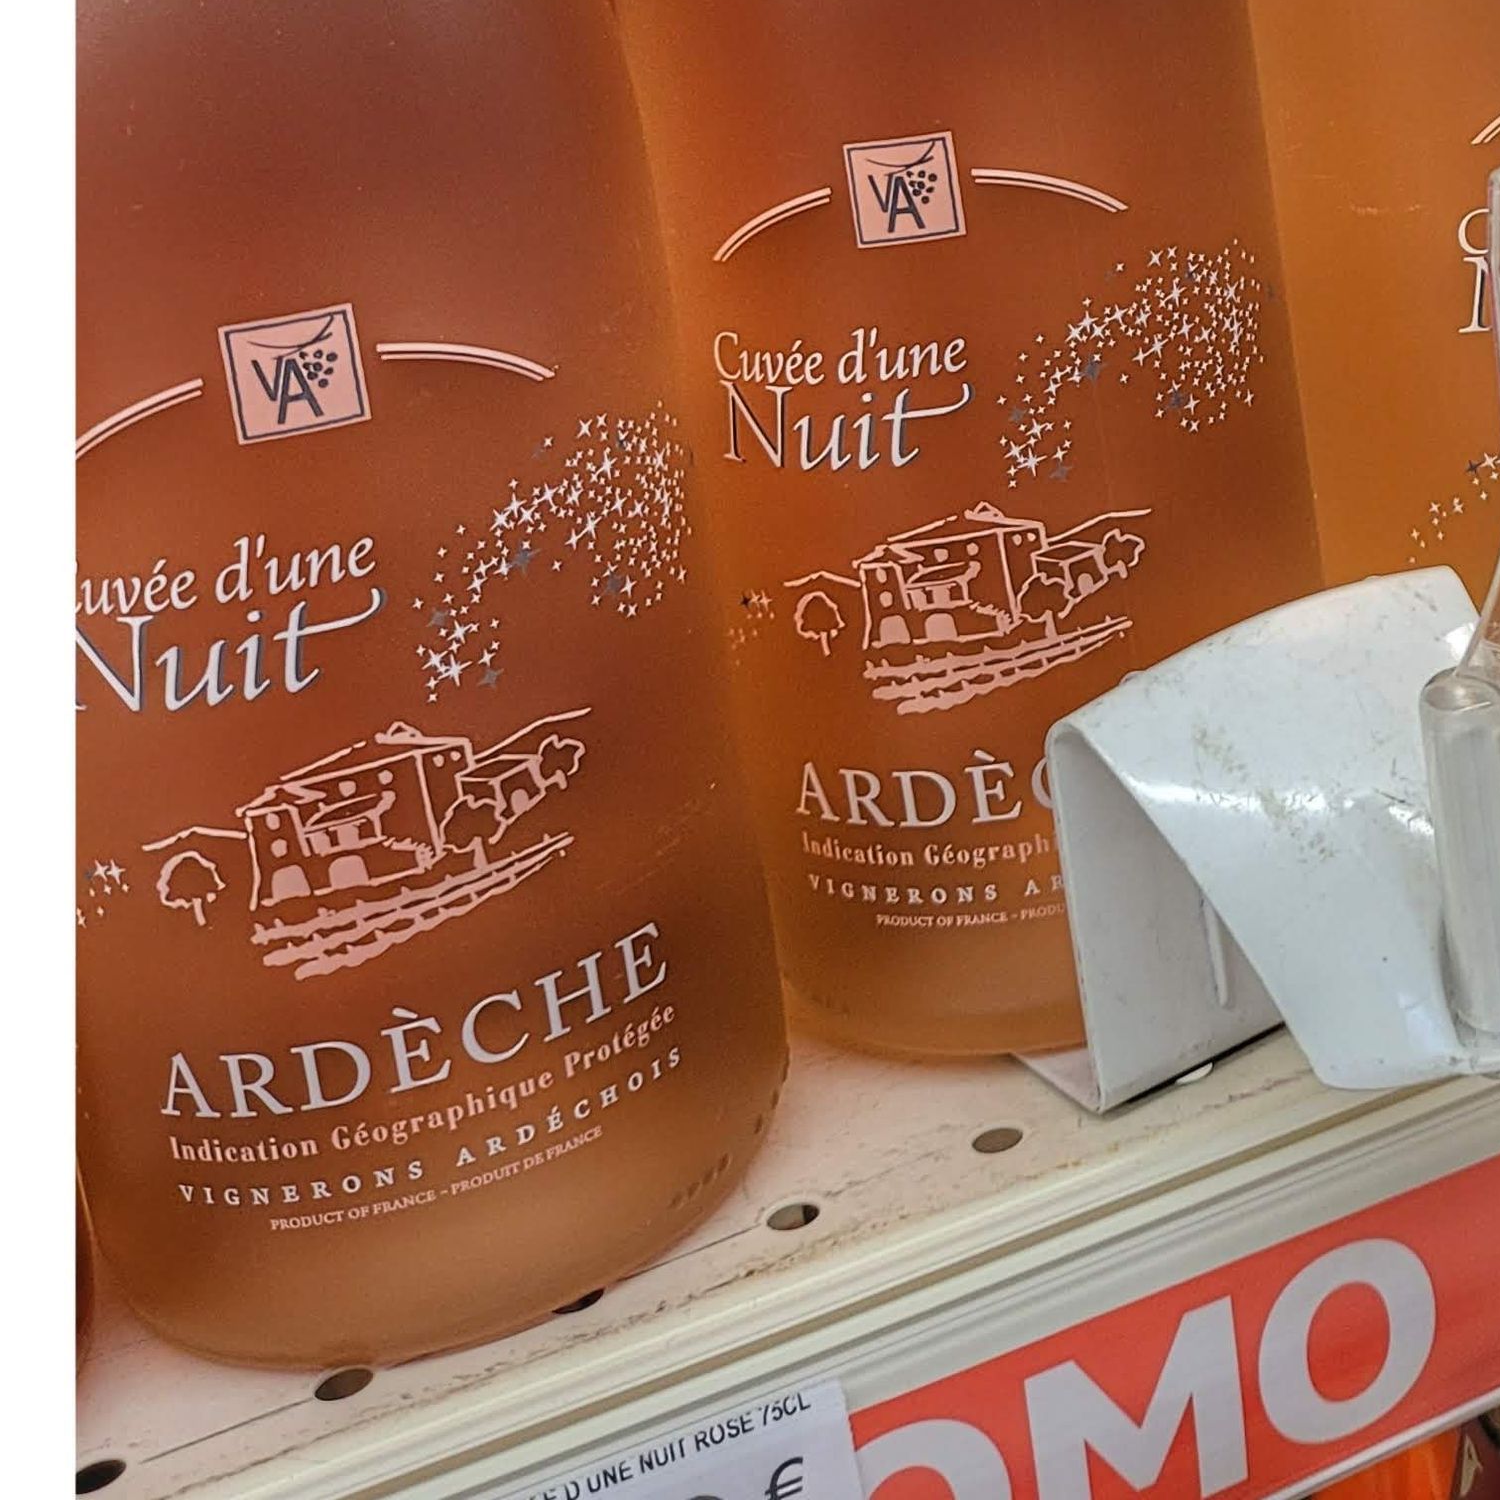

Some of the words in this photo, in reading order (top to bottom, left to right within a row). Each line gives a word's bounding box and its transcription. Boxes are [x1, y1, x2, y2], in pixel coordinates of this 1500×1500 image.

[713, 330, 826, 386] Cuvée
[837, 327, 969, 386] d'une
[722, 381, 974, 472] Nuit
[76, 559, 197, 615] uvée
[215, 534, 375, 603] d'une
[802, 831, 914, 866] Indication
[807, 874, 998, 904] VIGNERONS
[877, 913, 934, 928] PRODUCT
[936, 916, 954, 928] OF
[956, 911, 1008, 928] FRANCE
[161, 922, 669, 1120] ARDÈCHE
[169, 1136, 319, 1163] Indication
[331, 1071, 555, 1145] Géographique
[563, 1004, 676, 1078] Protégée
[178, 1160, 424, 1206] VIGNERONS
[456, 1047, 681, 1168] ARDÉCHOIS
[270, 1210, 345, 1231] PRODUCT
[348, 1206, 371, 1222] OF
[372, 1189, 437, 1217] FRANCE
[450, 1163, 522, 1196] PRODUIT
[523, 1152, 545, 1171] DE
[546, 1125, 604, 1161] FRANCE
[639, 1439, 687, 1474] NUIT
